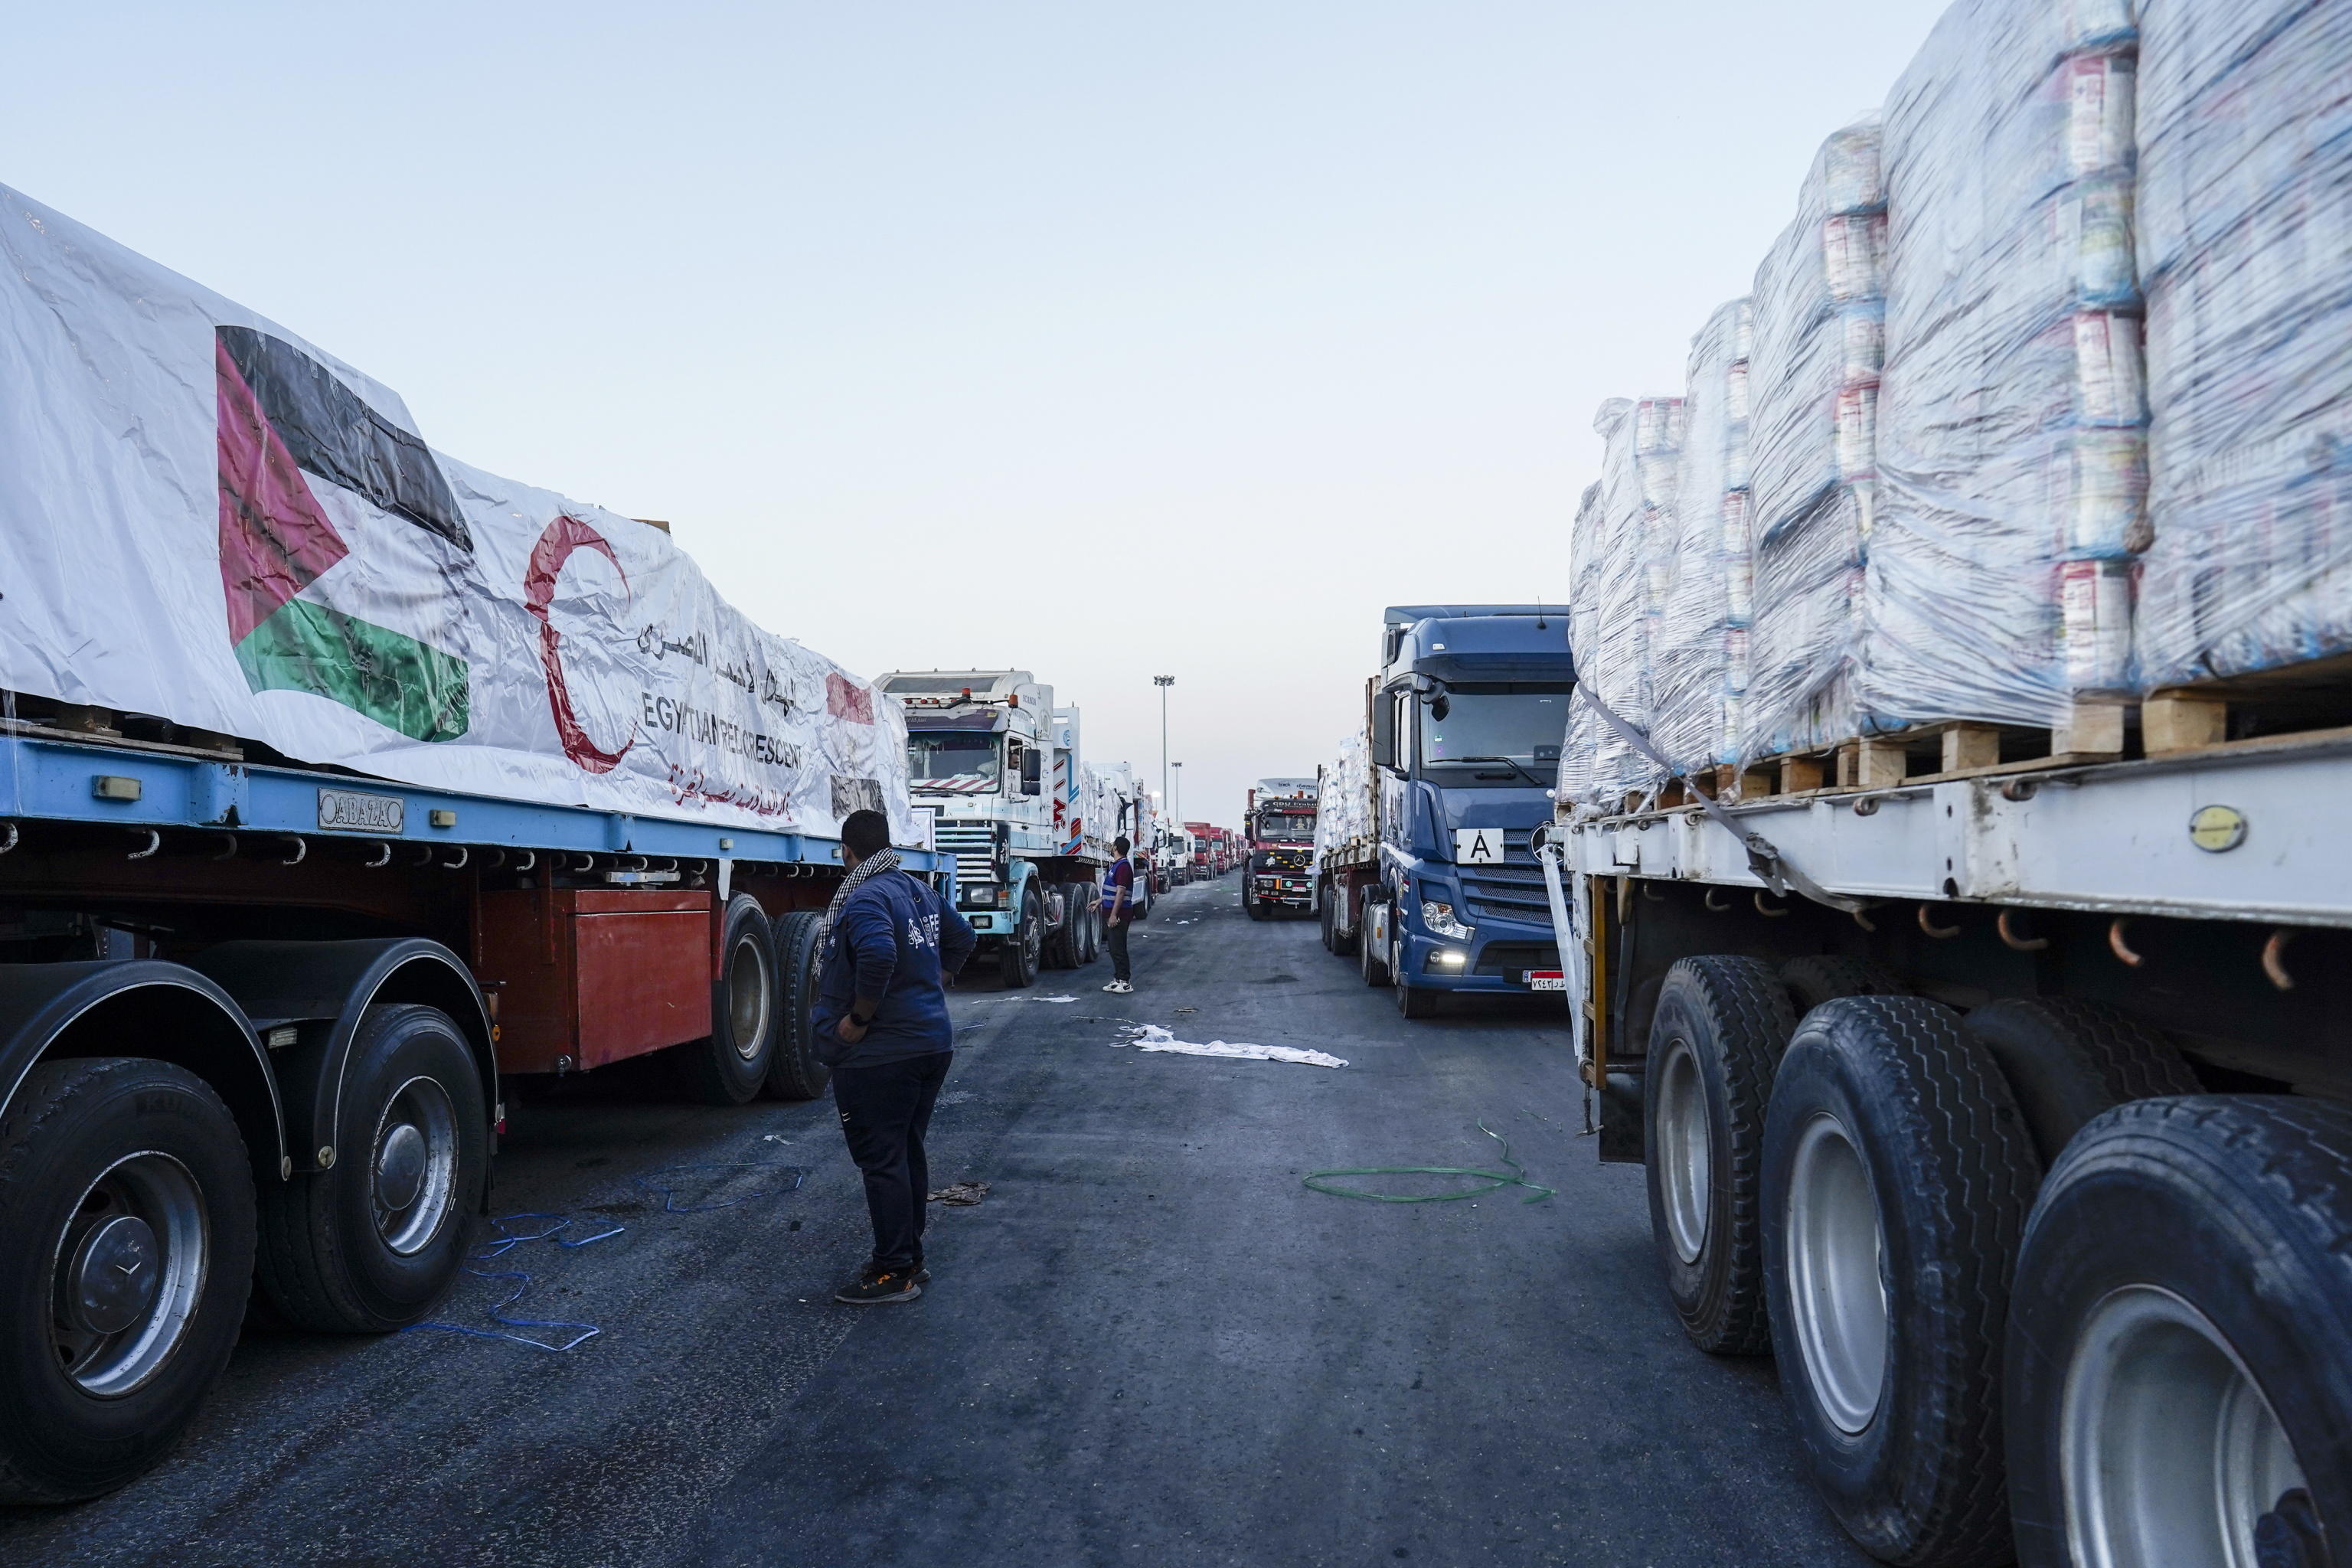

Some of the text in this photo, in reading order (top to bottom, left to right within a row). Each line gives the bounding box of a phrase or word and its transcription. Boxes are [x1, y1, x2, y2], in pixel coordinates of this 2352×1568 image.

[642, 691, 802, 770] EGYPTIAN RED CRESCENT
[336, 797, 388, 827] ABAZA
[1470, 834, 1491, 858] A
